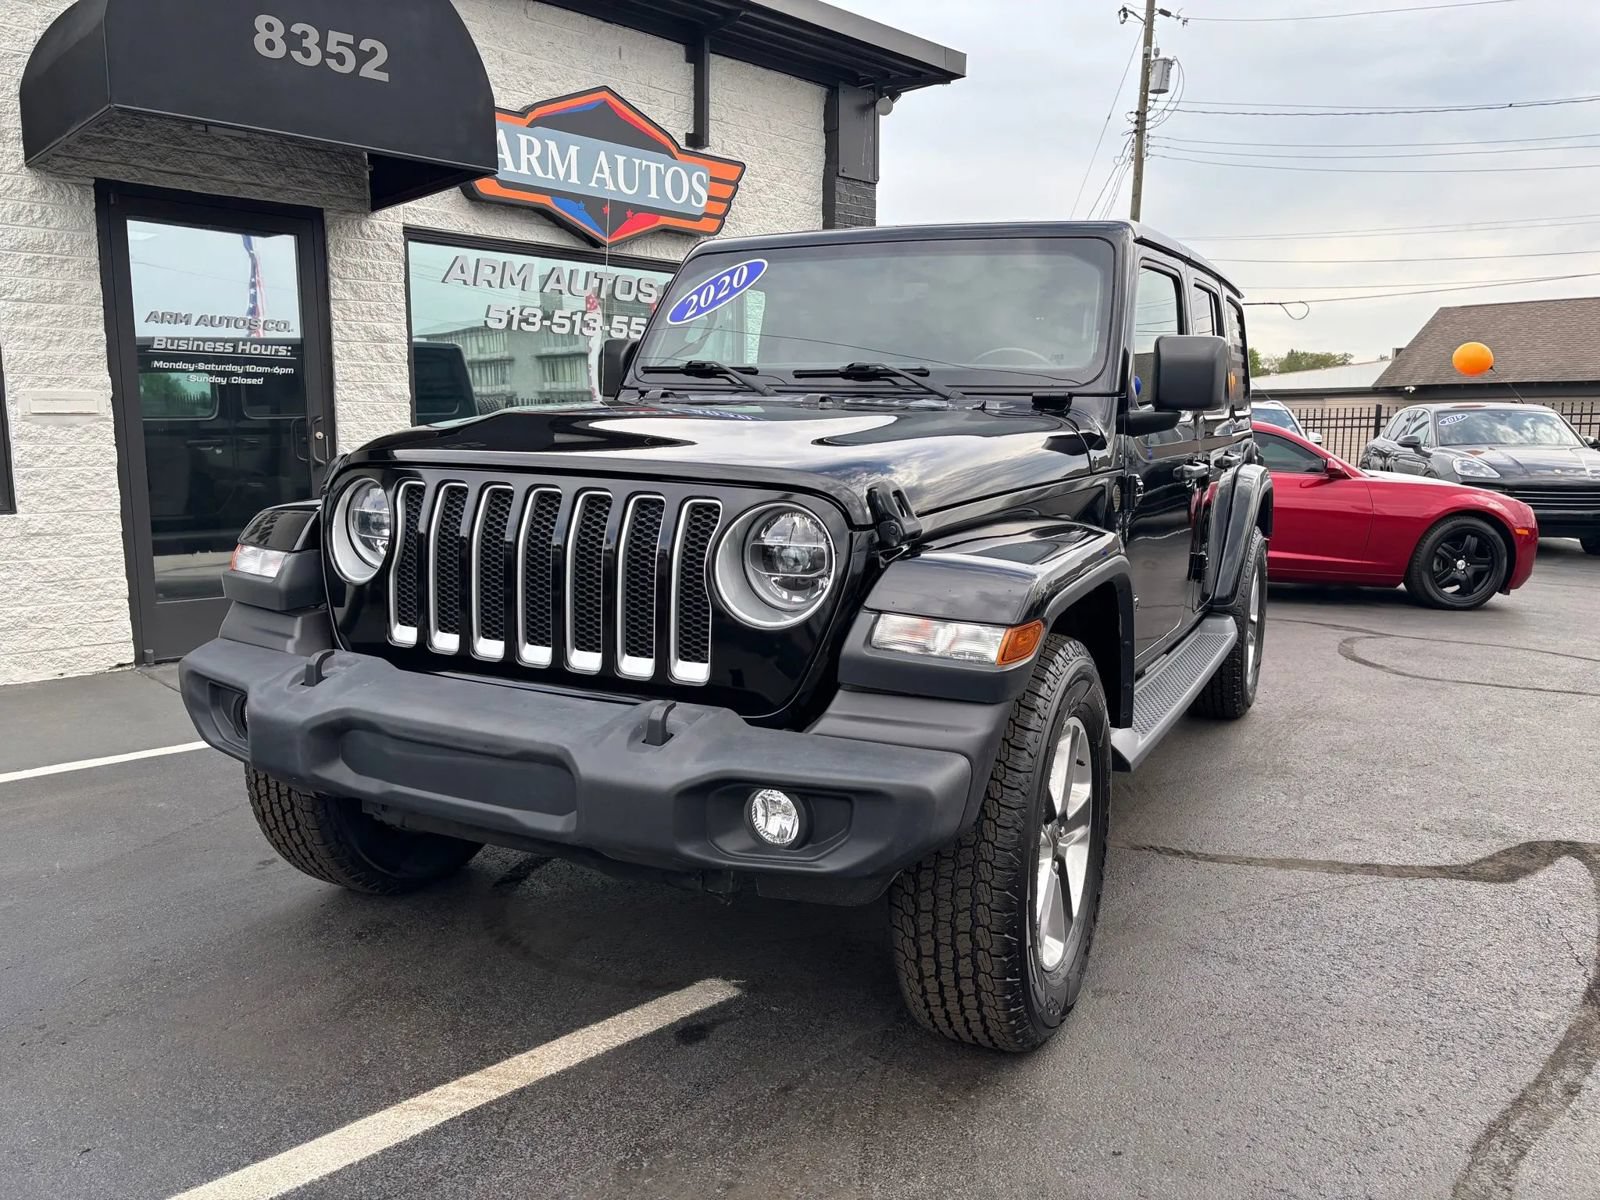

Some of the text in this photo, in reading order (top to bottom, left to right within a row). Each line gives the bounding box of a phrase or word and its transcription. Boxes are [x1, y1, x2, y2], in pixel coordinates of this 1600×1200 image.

[253, 14, 389, 82] 8352
[496, 128, 709, 207] ARM AUTOS
[441, 255, 658, 304] ARM AUTOS
[683, 265, 748, 319] 2020
[144, 310, 294, 333] ARM AUTOS CO.
[152, 336, 292, 356] Business Hours:
[152, 360, 294, 375] Monday-Saturday 10am-6pm
[188, 374, 264, 386] Sunday Closed
